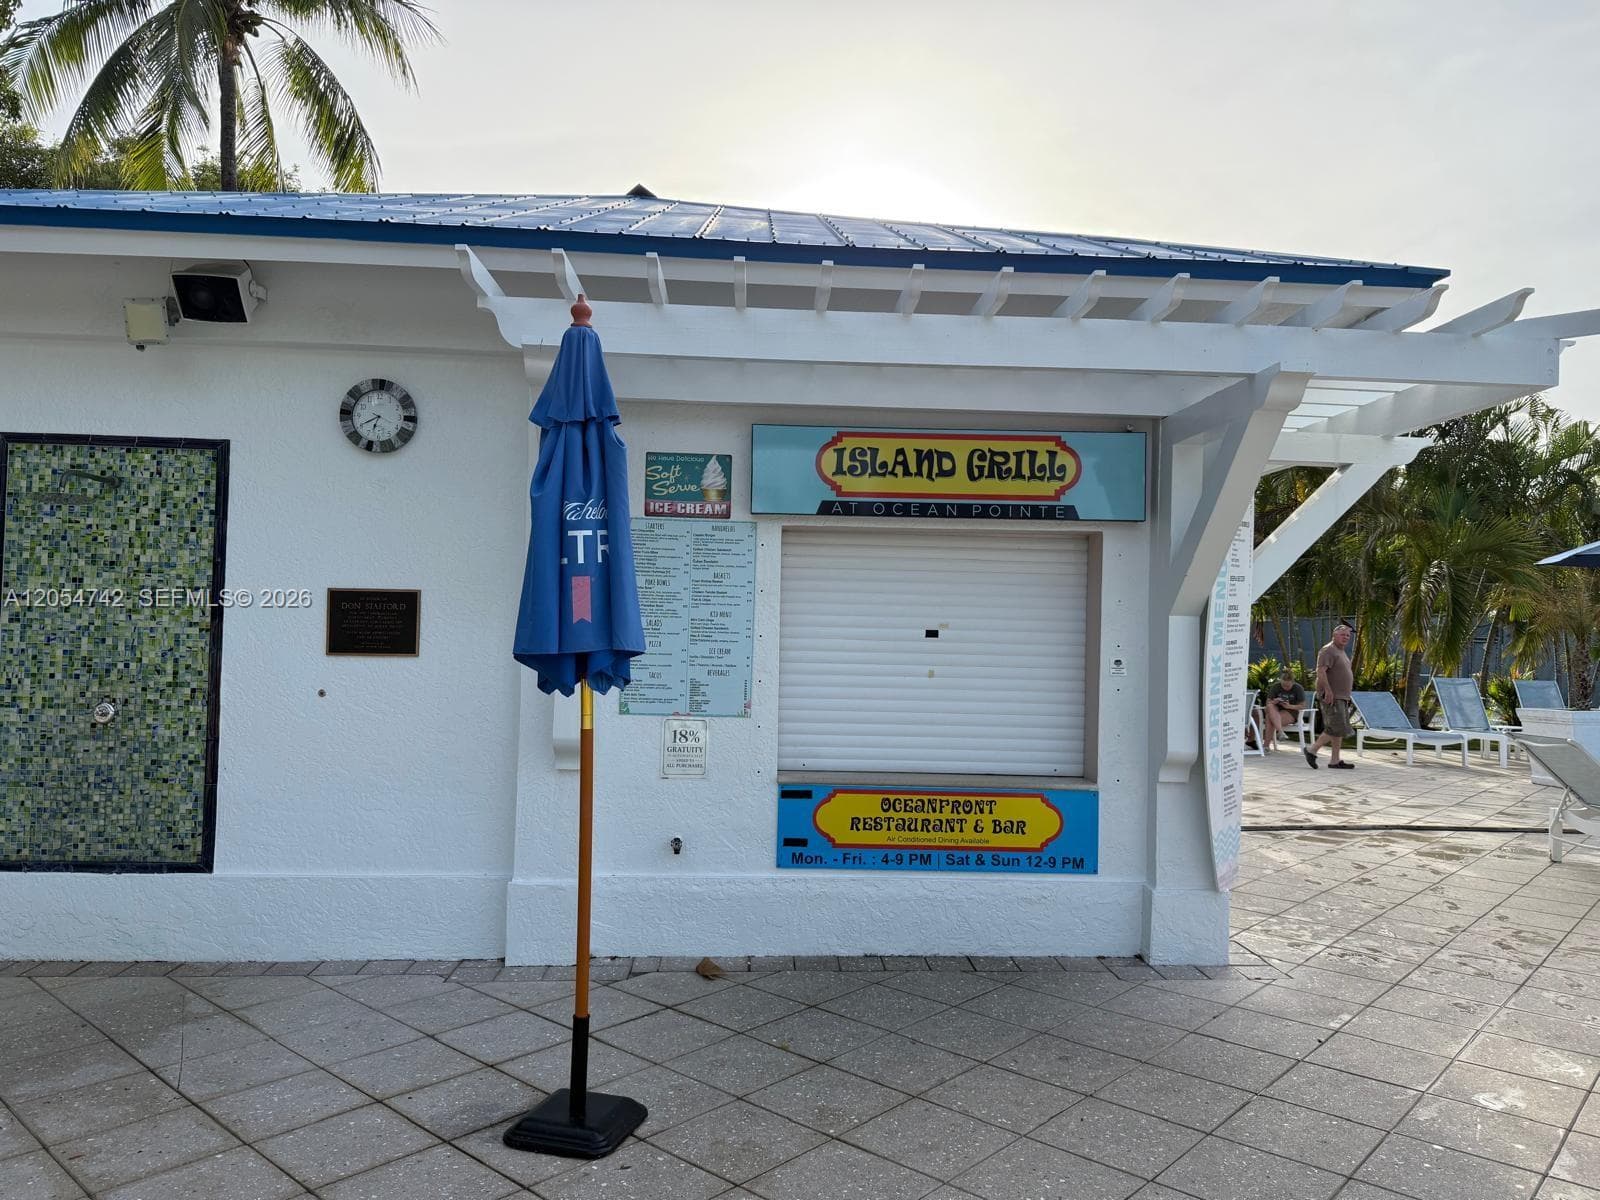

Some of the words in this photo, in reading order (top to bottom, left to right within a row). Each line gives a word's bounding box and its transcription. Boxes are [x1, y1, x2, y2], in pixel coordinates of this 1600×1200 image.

[832, 446, 957, 482] ISLAND
[966, 447, 1067, 483] GRILL
[645, 464, 682, 483] Soft
[652, 480, 700, 496] Serve
[649, 502, 673, 513] ICE
[676, 502, 727, 515] CREAM
[831, 502, 858, 514] AT
[873, 503, 957, 516] OCEAN
[972, 504, 1065, 518] POINTE
[645, 619, 663, 627] SALADS
[648, 640, 662, 648] PIZZA
[1209, 655, 1221, 749] DRINK
[672, 729, 700, 744] 18%
[880, 797, 997, 815] OCEANFRONT
[849, 816, 967, 833] RESTAURANT
[973, 818, 985, 834] &
[991, 819, 1027, 835] BAR
[897, 835, 937, 843] Conditioned
[938, 836, 959, 845] Dining
[960, 837, 990, 845] Available
[791, 852, 828, 865] Mon.
[842, 852, 866, 865] Fri.
[881, 853, 904, 866] 4-9
[908, 853, 932, 866] PM
[945, 853, 971, 867] Sat
[975, 853, 986, 867] &
[990, 854, 1021, 868] Sun
[1025, 855, 1057, 868] 12-9
[1061, 857, 1085, 870] PM
